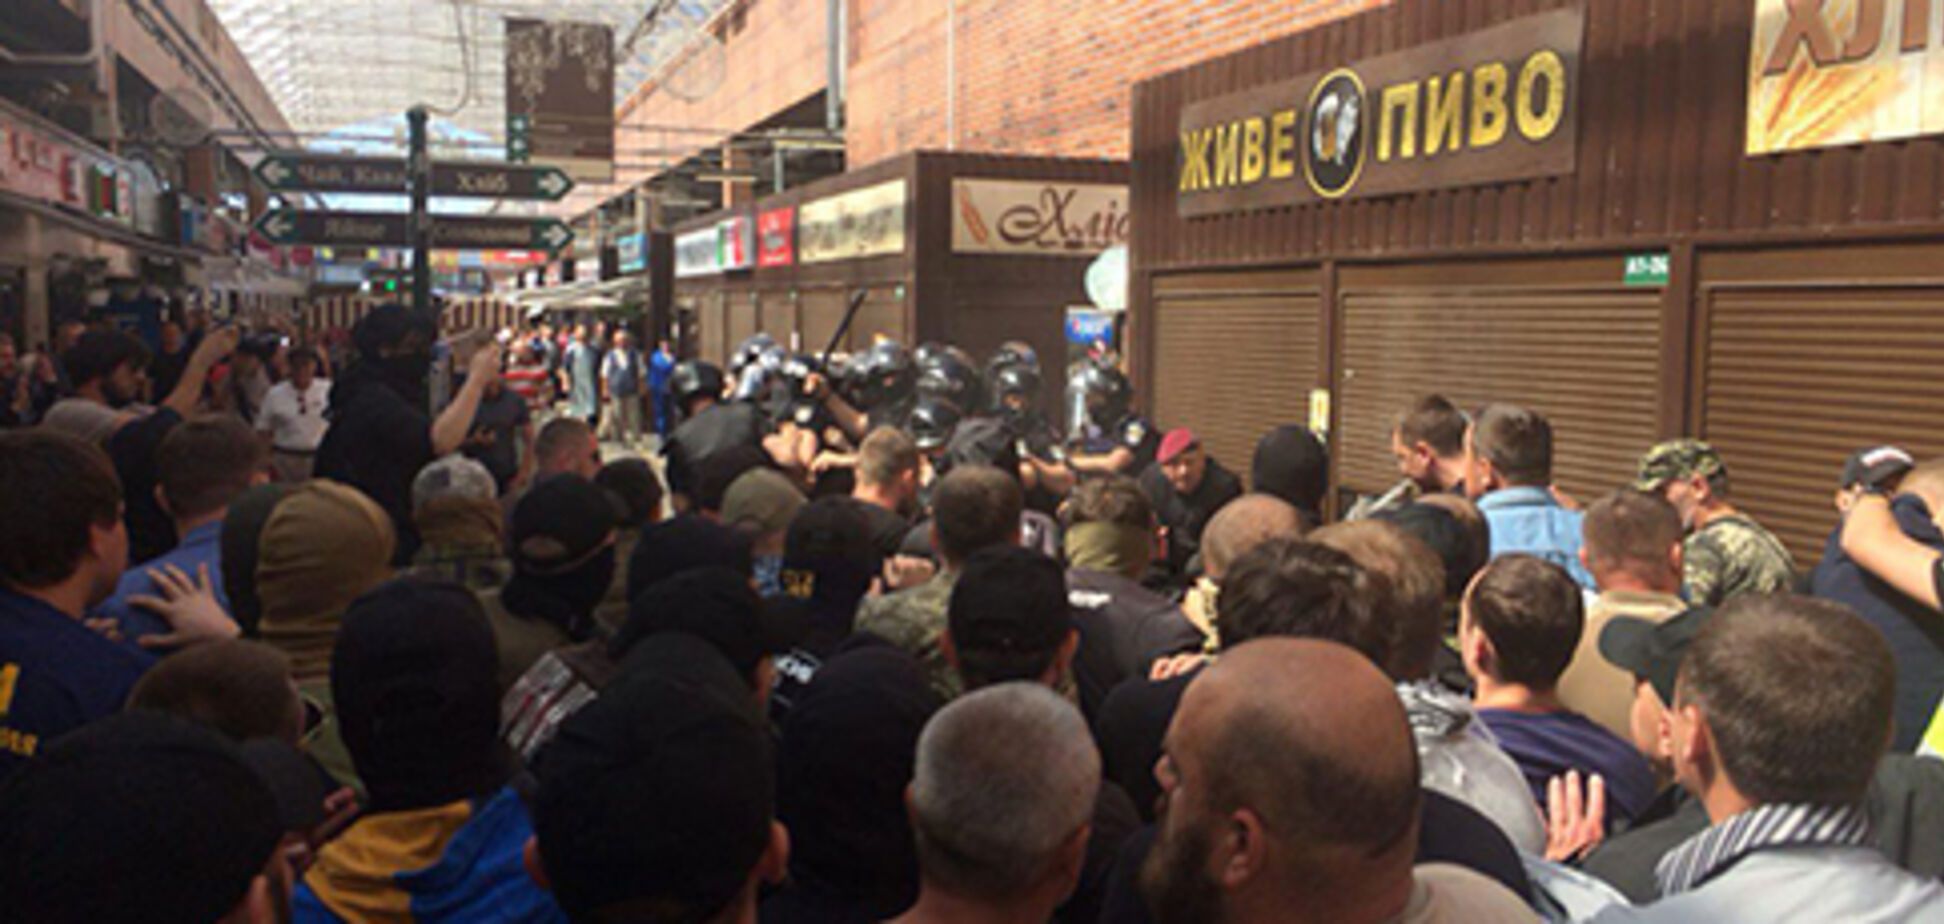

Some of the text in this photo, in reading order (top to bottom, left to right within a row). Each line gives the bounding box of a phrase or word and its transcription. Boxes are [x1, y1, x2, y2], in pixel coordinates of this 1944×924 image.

[1179, 50, 1564, 192] ЖИВЕ ПИВО
[456, 171, 508, 193] Хліб
